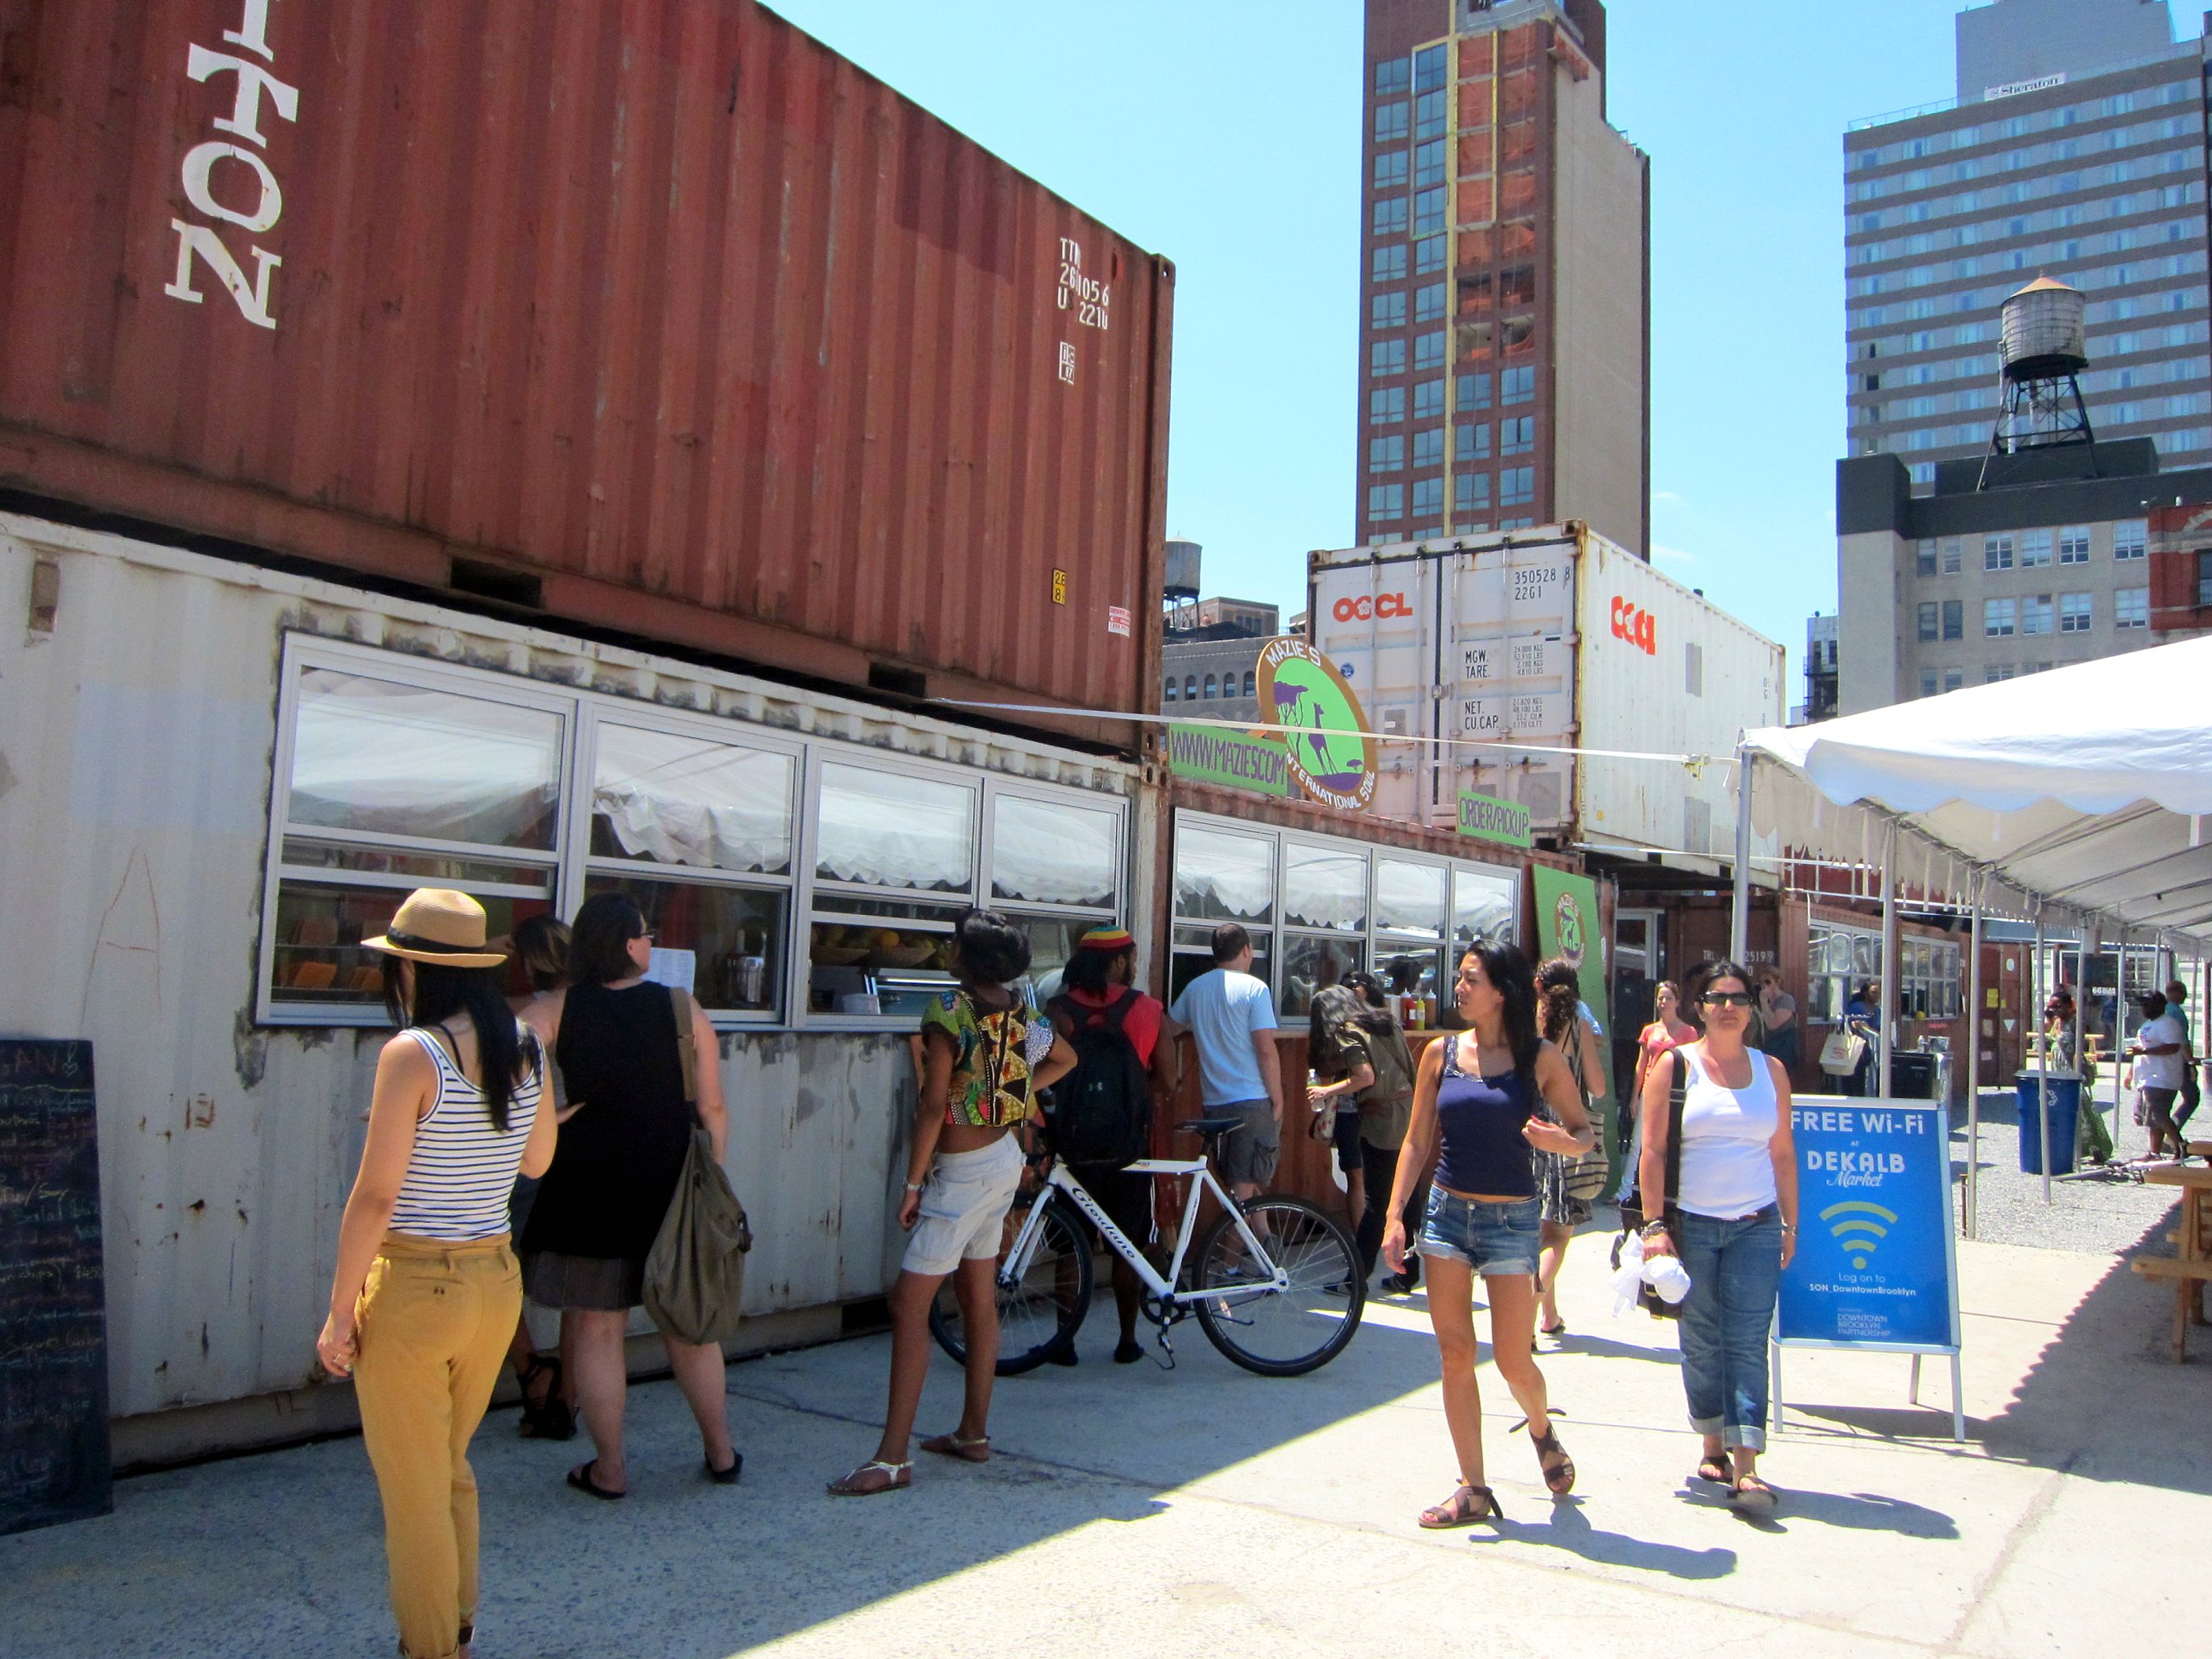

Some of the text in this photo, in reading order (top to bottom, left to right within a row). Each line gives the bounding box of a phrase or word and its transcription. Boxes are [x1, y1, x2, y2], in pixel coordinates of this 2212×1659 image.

[2001, 77, 2058, 95] Sheraton
[1515, 566, 1571, 585] 350528 8
[1515, 585, 1542, 600] 22G1
[1265, 639, 1322, 668] MAZIE'S
[1465, 650, 1489, 663] MGW.
[1465, 665, 1491, 679] TARE.
[1464, 701, 1485, 715] NET.
[1287, 748, 1375, 810] NTERNATIONAL SOUL
[1459, 797, 1529, 838] ORDER/PICKUP
[1790, 1111, 1925, 1135] FREE Wi-Fi
[1807, 1151, 1906, 1173] DEKALB
[1826, 1170, 1884, 1189] Market
[1072, 1187, 1135, 1259] Giordano
[1839, 1273, 1857, 1284] Log
[1875, 1275, 1886, 1283] to
[1838, 1314, 1888, 1323] DOWNTOWN
[1838, 1321, 1881, 1329] BROOKLYN
[1838, 1328, 1891, 1337] PARTNERSHIP
